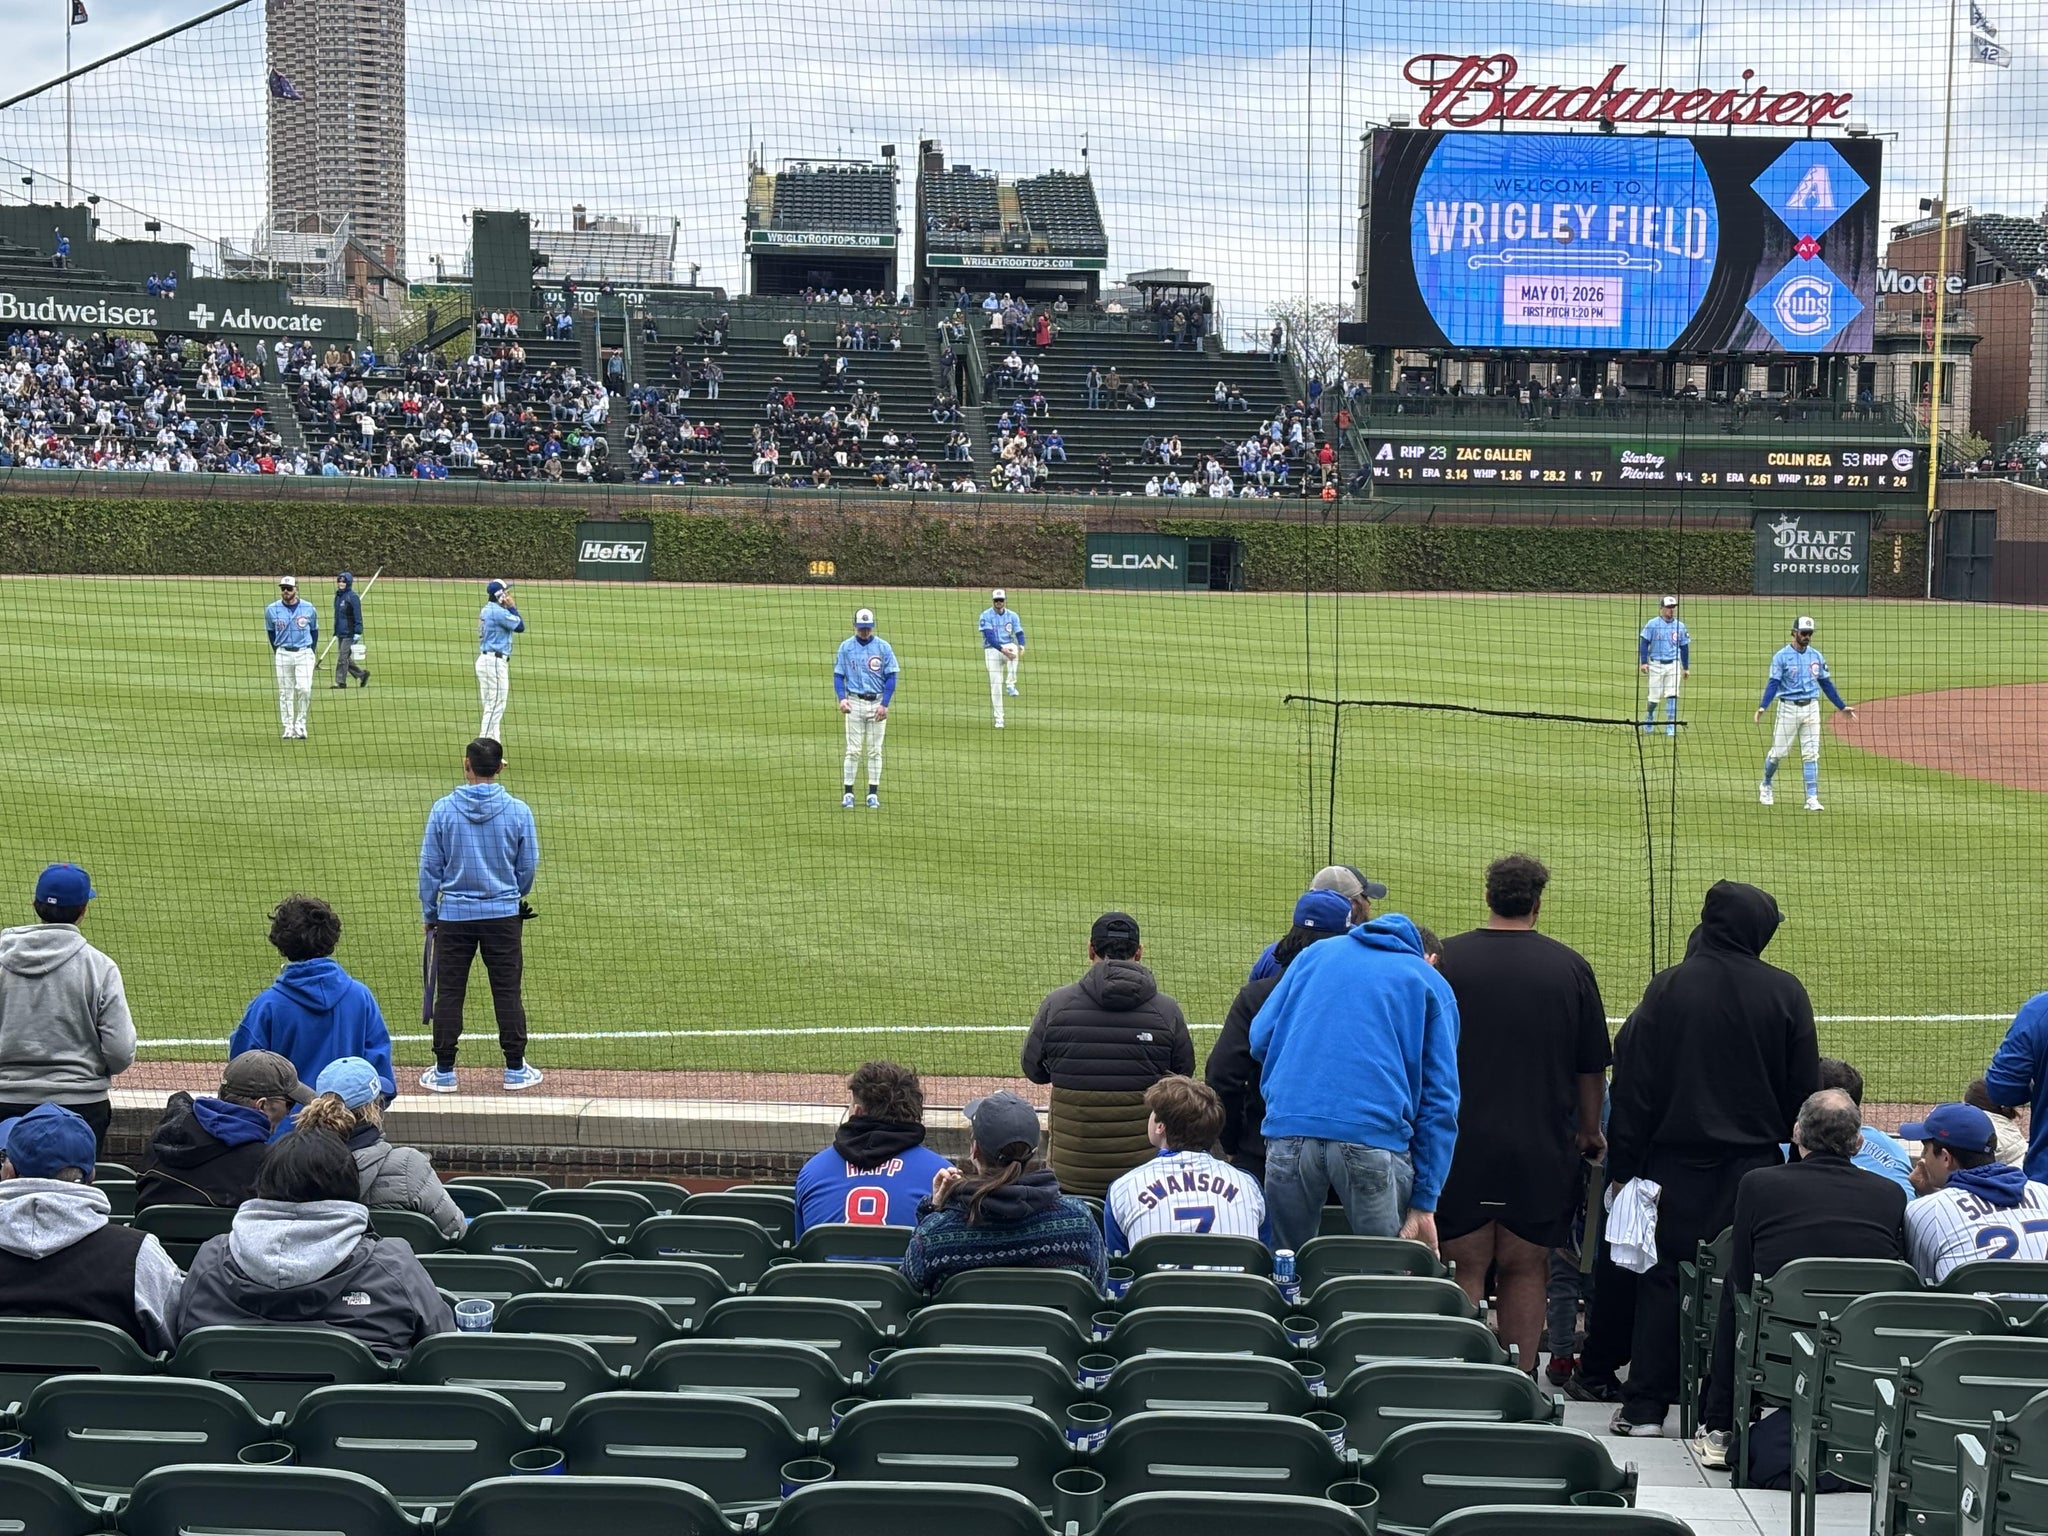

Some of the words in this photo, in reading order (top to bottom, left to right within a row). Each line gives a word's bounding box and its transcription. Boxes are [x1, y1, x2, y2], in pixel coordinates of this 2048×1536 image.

[1980, 47, 1999, 61] 42
[1403, 54, 1853, 127] Budweiser
[1494, 178, 1603, 193] WELCOME
[1614, 181, 1642, 194] TO
[1425, 201, 1598, 256] WRIGLEY
[1608, 205, 1708, 260] FIELD
[1799, 244, 1816, 252] AT
[1521, 286, 1547, 301] MAY
[1551, 286, 1569, 303] 01,
[1572, 287, 1604, 302] 2026
[0, 293, 152, 326] Budweiser
[1523, 307, 1545, 317] FIRST
[1547, 307, 1570, 317] PITCH
[1572, 308, 1590, 318] 1:20
[1592, 308, 1603, 318] PM
[221, 308, 322, 332] Advocate
[1401, 446, 1425, 458] RHP
[1429, 447, 1446, 460] 23
[1457, 448, 1481, 461] ZAC
[1484, 449, 1531, 461] GALLEN
[1620, 450, 1665, 466] Starting
[1768, 453, 1804, 466] COLIN
[1807, 454, 1831, 467] REA
[1842, 454, 1859, 466] 53
[1863, 454, 1888, 466] RHP
[1373, 467, 1390, 477] W-L
[1398, 469, 1413, 479] 1-1
[1423, 469, 1440, 478] ERA
[1445, 469, 1468, 480] 3.14
[1474, 469, 1497, 478] WHIP
[1501, 470, 1522, 481] 1.36
[1530, 470, 1539, 479] IP
[1543, 470, 1566, 481] 28.2
[1575, 470, 1582, 479] K
[1591, 471, 1602, 481] 17
[1620, 466, 1665, 481] Pitchers
[1676, 472, 1693, 482] W-L
[1701, 473, 1717, 484] 3-1
[1726, 473, 1744, 483] ERA
[1750, 474, 1771, 485] 4.61
[1778, 473, 1801, 483] WHIP
[1805, 475, 1826, 485] 1.28
[1834, 475, 1843, 484] IP
[1848, 475, 1868, 486] 27.1
[1879, 476, 1886, 485] K
[1893, 477, 1907, 487] 24
[1773, 529, 1856, 547] DRAFT
[584, 543, 642, 561] Hefty
[1784, 546, 1853, 561] KINGS
[1773, 563, 1860, 574] SPORTSBOOK
[1138, 1171, 1239, 1209] SWANSON
[1957, 1188, 2040, 1221] SUKI
[1174, 1205, 1216, 1234] 7
